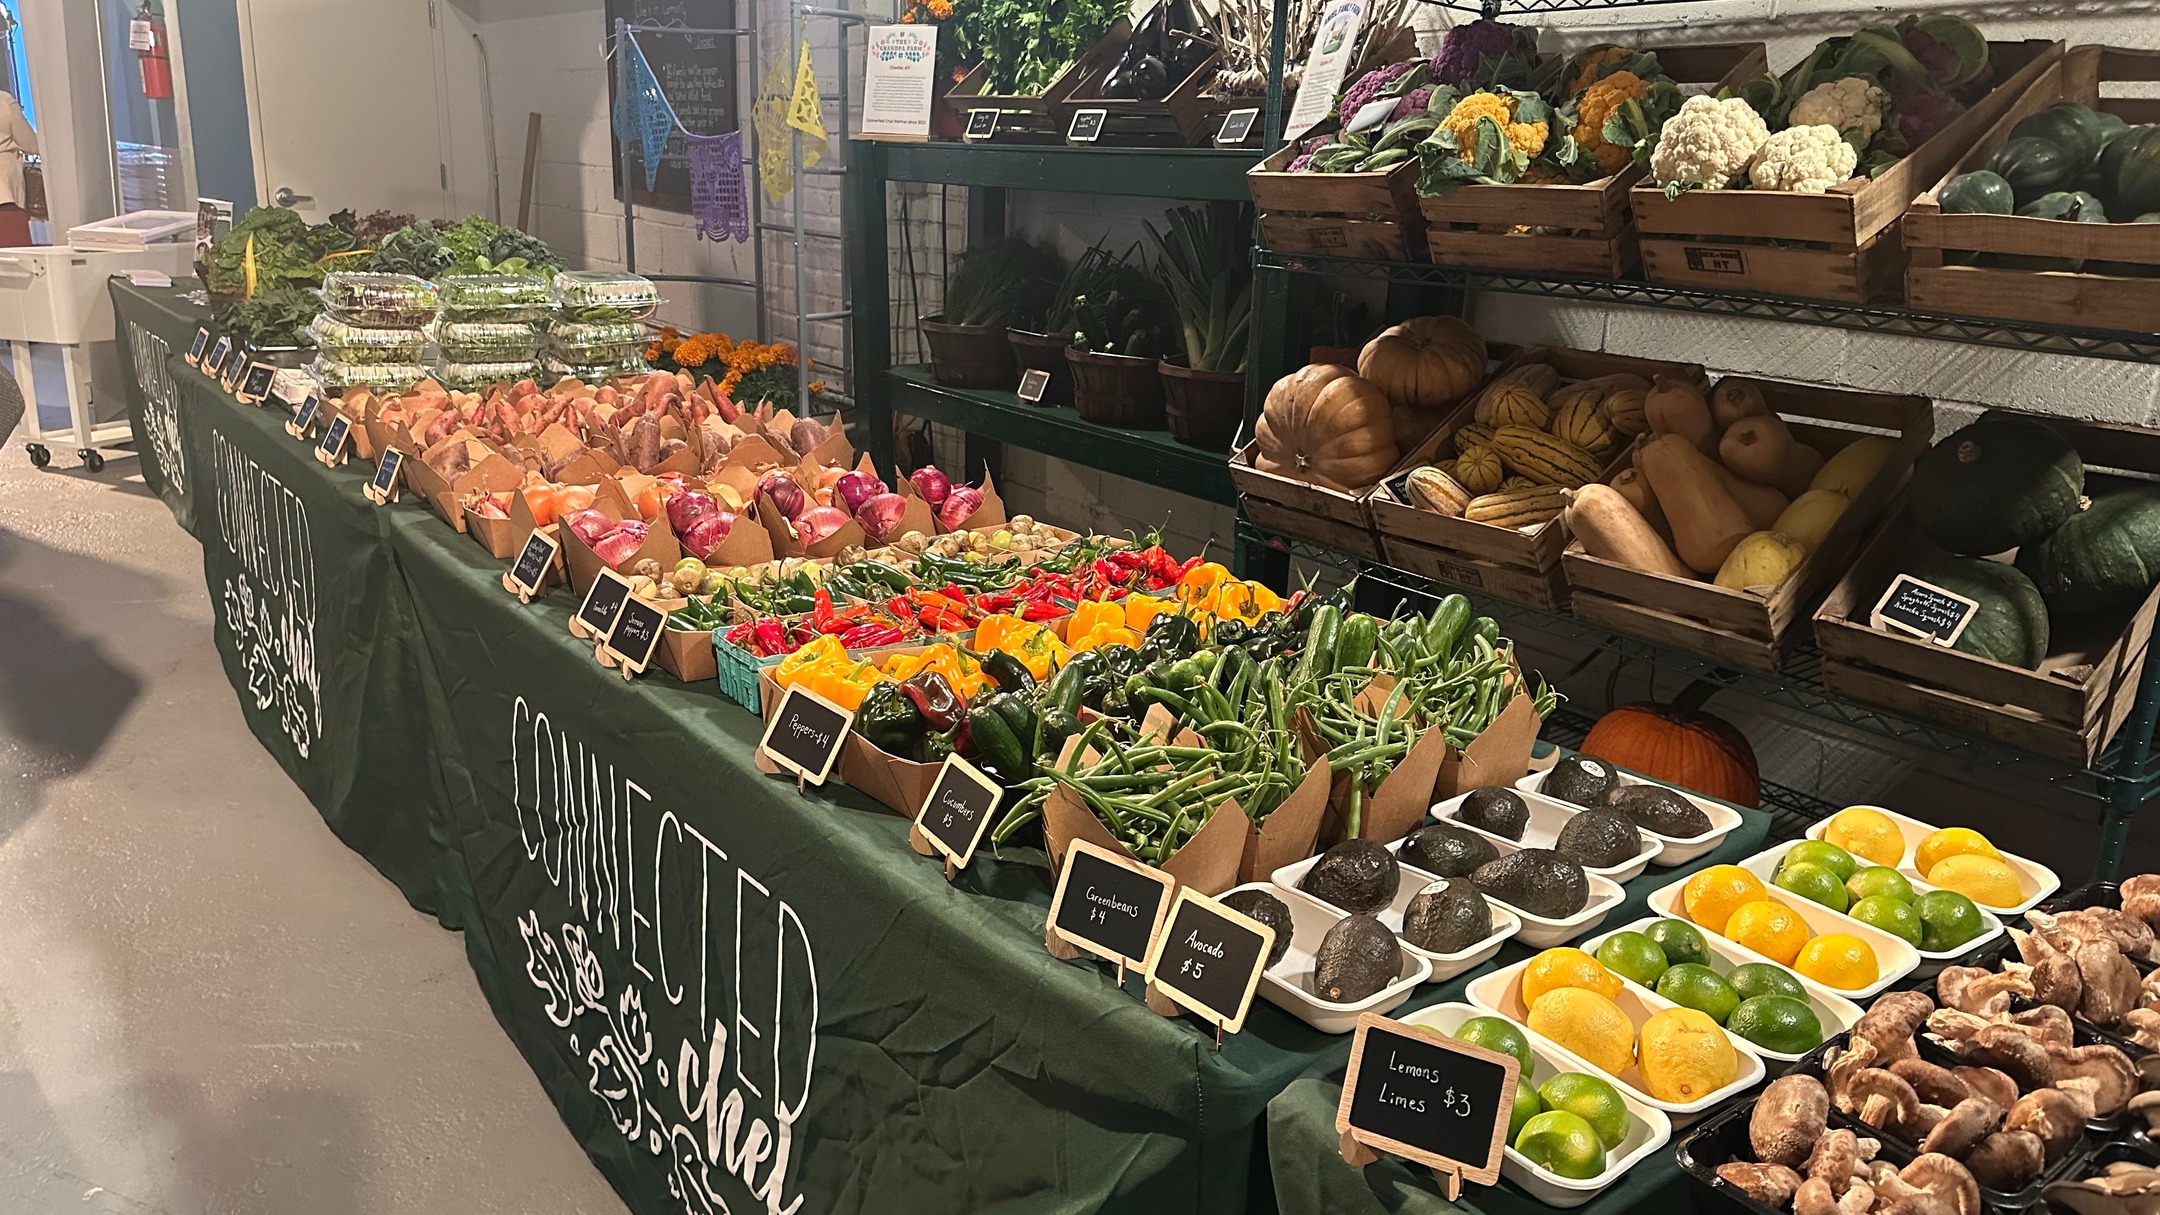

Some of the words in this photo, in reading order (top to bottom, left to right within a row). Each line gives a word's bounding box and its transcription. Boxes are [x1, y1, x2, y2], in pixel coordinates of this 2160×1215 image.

[213, 429, 316, 632] CONNECTED
[1901, 592, 1931, 608] Spaghetti
[1930, 603, 1951, 615] Squash
[1911, 588, 1928, 599] Acorn
[1928, 593, 1946, 605] Squash
[1946, 600, 1959, 610] $3
[1919, 609, 1941, 623] Squash
[1940, 616, 1953, 629] $4
[640, 628, 650, 641] $3
[942, 789, 975, 821] Cucumbers
[942, 812, 954, 828] $5
[513, 696, 818, 1125] CONNECTED
[1086, 886, 1139, 918] Greenbeans
[1184, 929, 1225, 959] Avocado
[1180, 958, 1205, 979] $5
[1389, 1050, 1440, 1084] Lemons
[1378, 1082, 1426, 1113] Limes
[1443, 1086, 1471, 1117] $3
